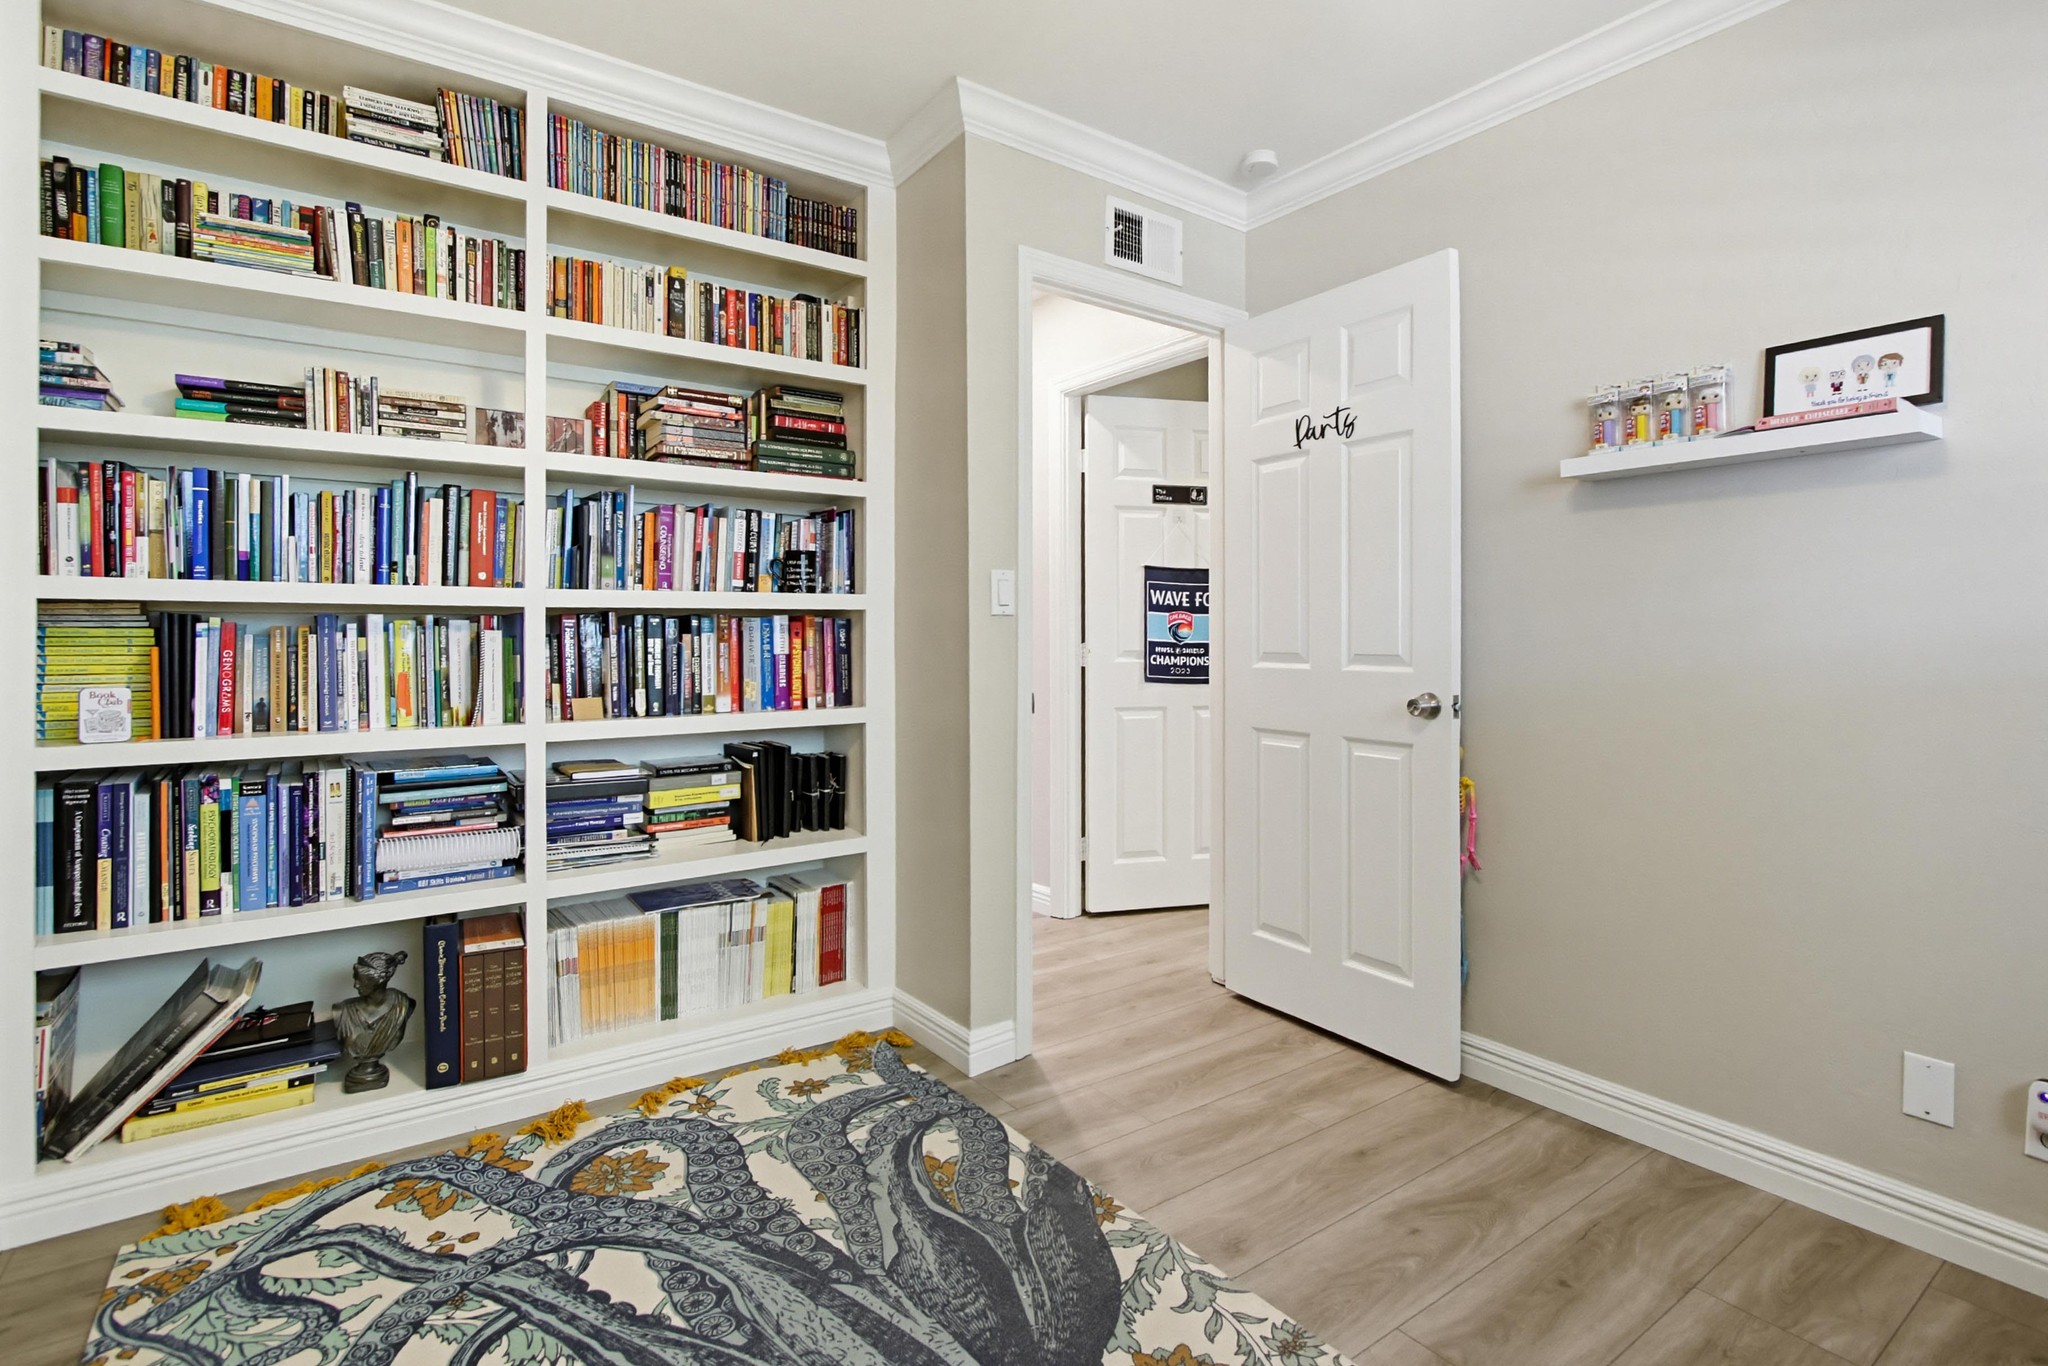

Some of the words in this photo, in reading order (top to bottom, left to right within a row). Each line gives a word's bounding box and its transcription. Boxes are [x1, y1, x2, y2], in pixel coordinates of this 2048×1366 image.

[1293, 406, 1357, 450] Parts
[659, 525, 668, 570] COUNSELING
[1150, 589, 1190, 607] WAVE
[1150, 654, 1209, 666] CHAMPIONS
[1182, 646, 1205, 654] SHIELD
[221, 649, 233, 713] GENOGRAMS
[1170, 667, 1191, 675] 2023
[89, 691, 116, 699] Book
[97, 698, 123, 709] Club
[232, 811, 240, 835] BEYOND
[365, 800, 373, 829] Counseling
[73, 815, 83, 850] Compendium
[97, 828, 111, 858] Creating
[186, 823, 199, 850] Seeking
[208, 810, 217, 879] PSYCHOPATHOLOGY
[101, 860, 109, 892] CHANGE
[429, 878, 444, 886] Skills
[437, 958, 447, 976] Disney
